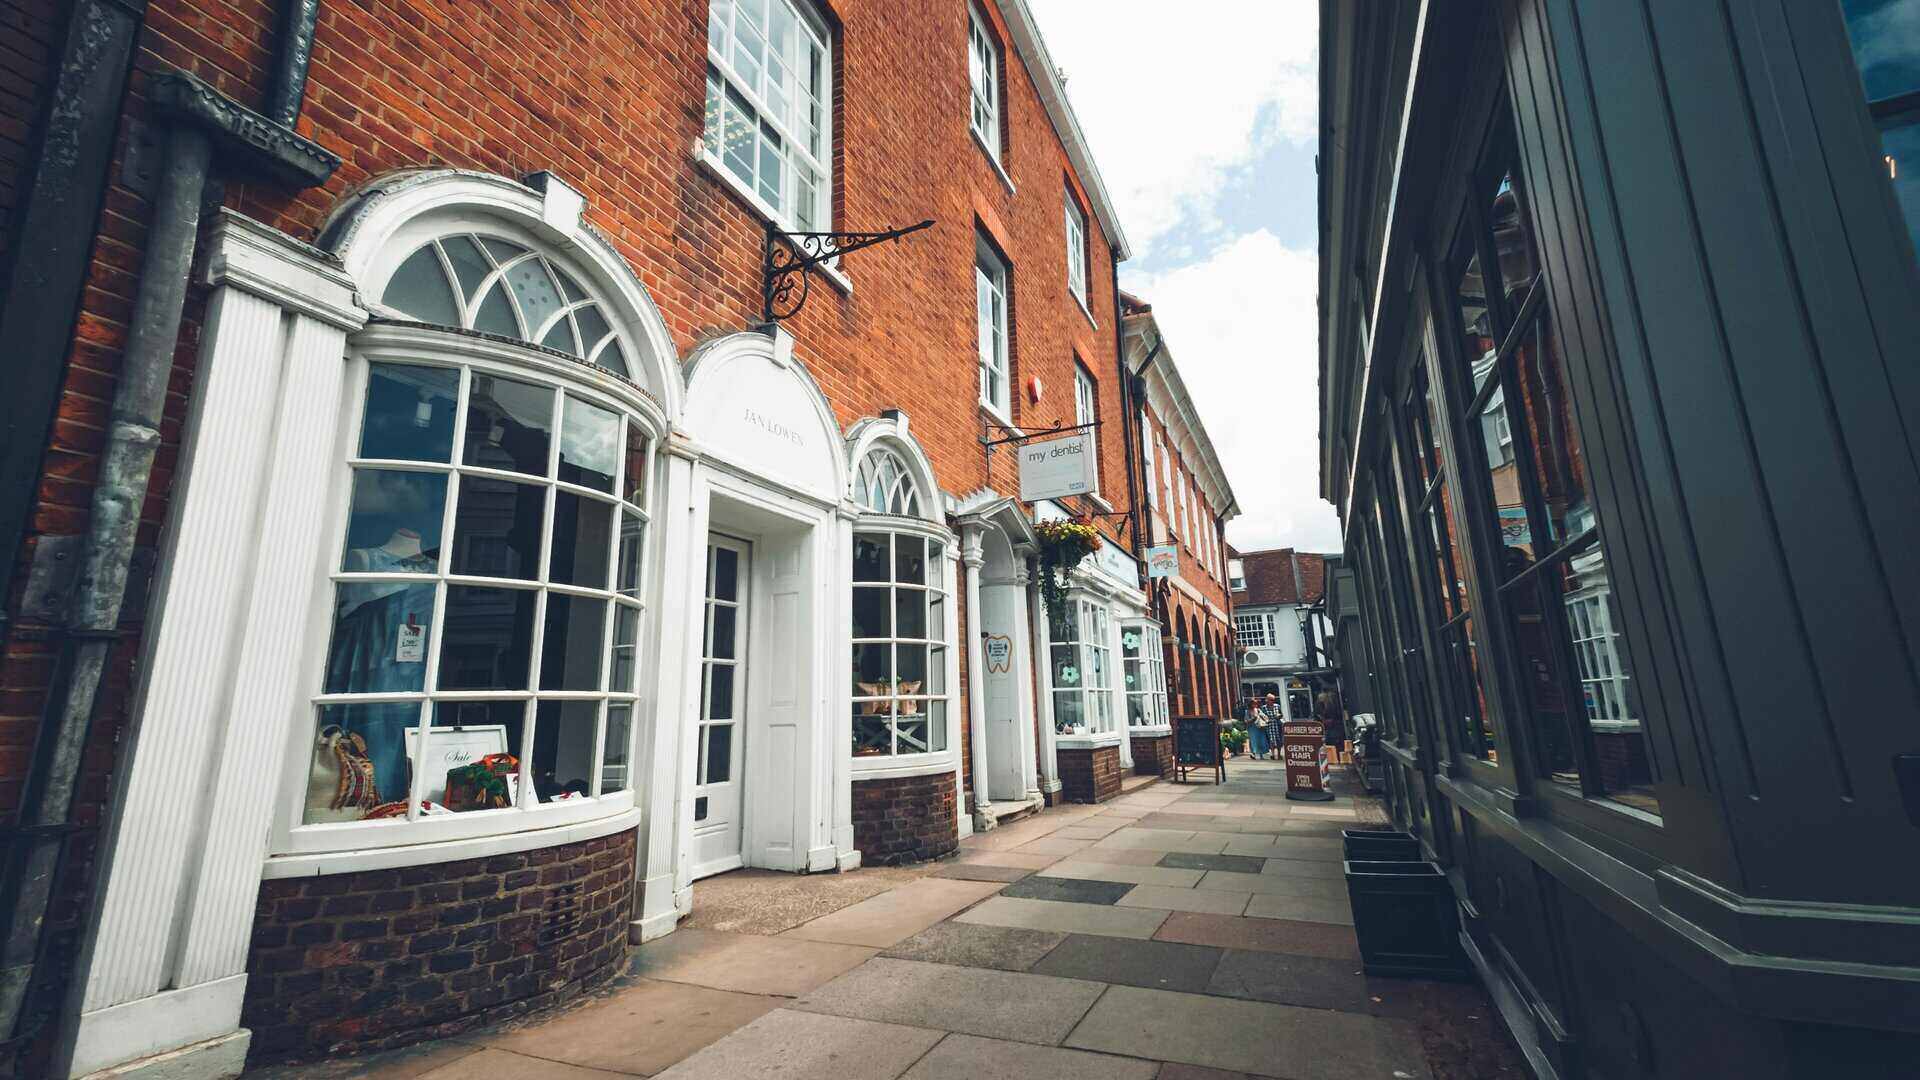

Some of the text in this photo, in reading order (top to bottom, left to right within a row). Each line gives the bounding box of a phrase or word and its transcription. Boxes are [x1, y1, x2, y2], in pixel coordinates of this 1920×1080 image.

[743, 408, 765, 430] JAN
[1028, 442, 1083, 463] my dentist
[1308, 726, 1322, 734] SHOP
[1287, 744, 1314, 752] GENTS
[445, 751, 472, 761] Sale
